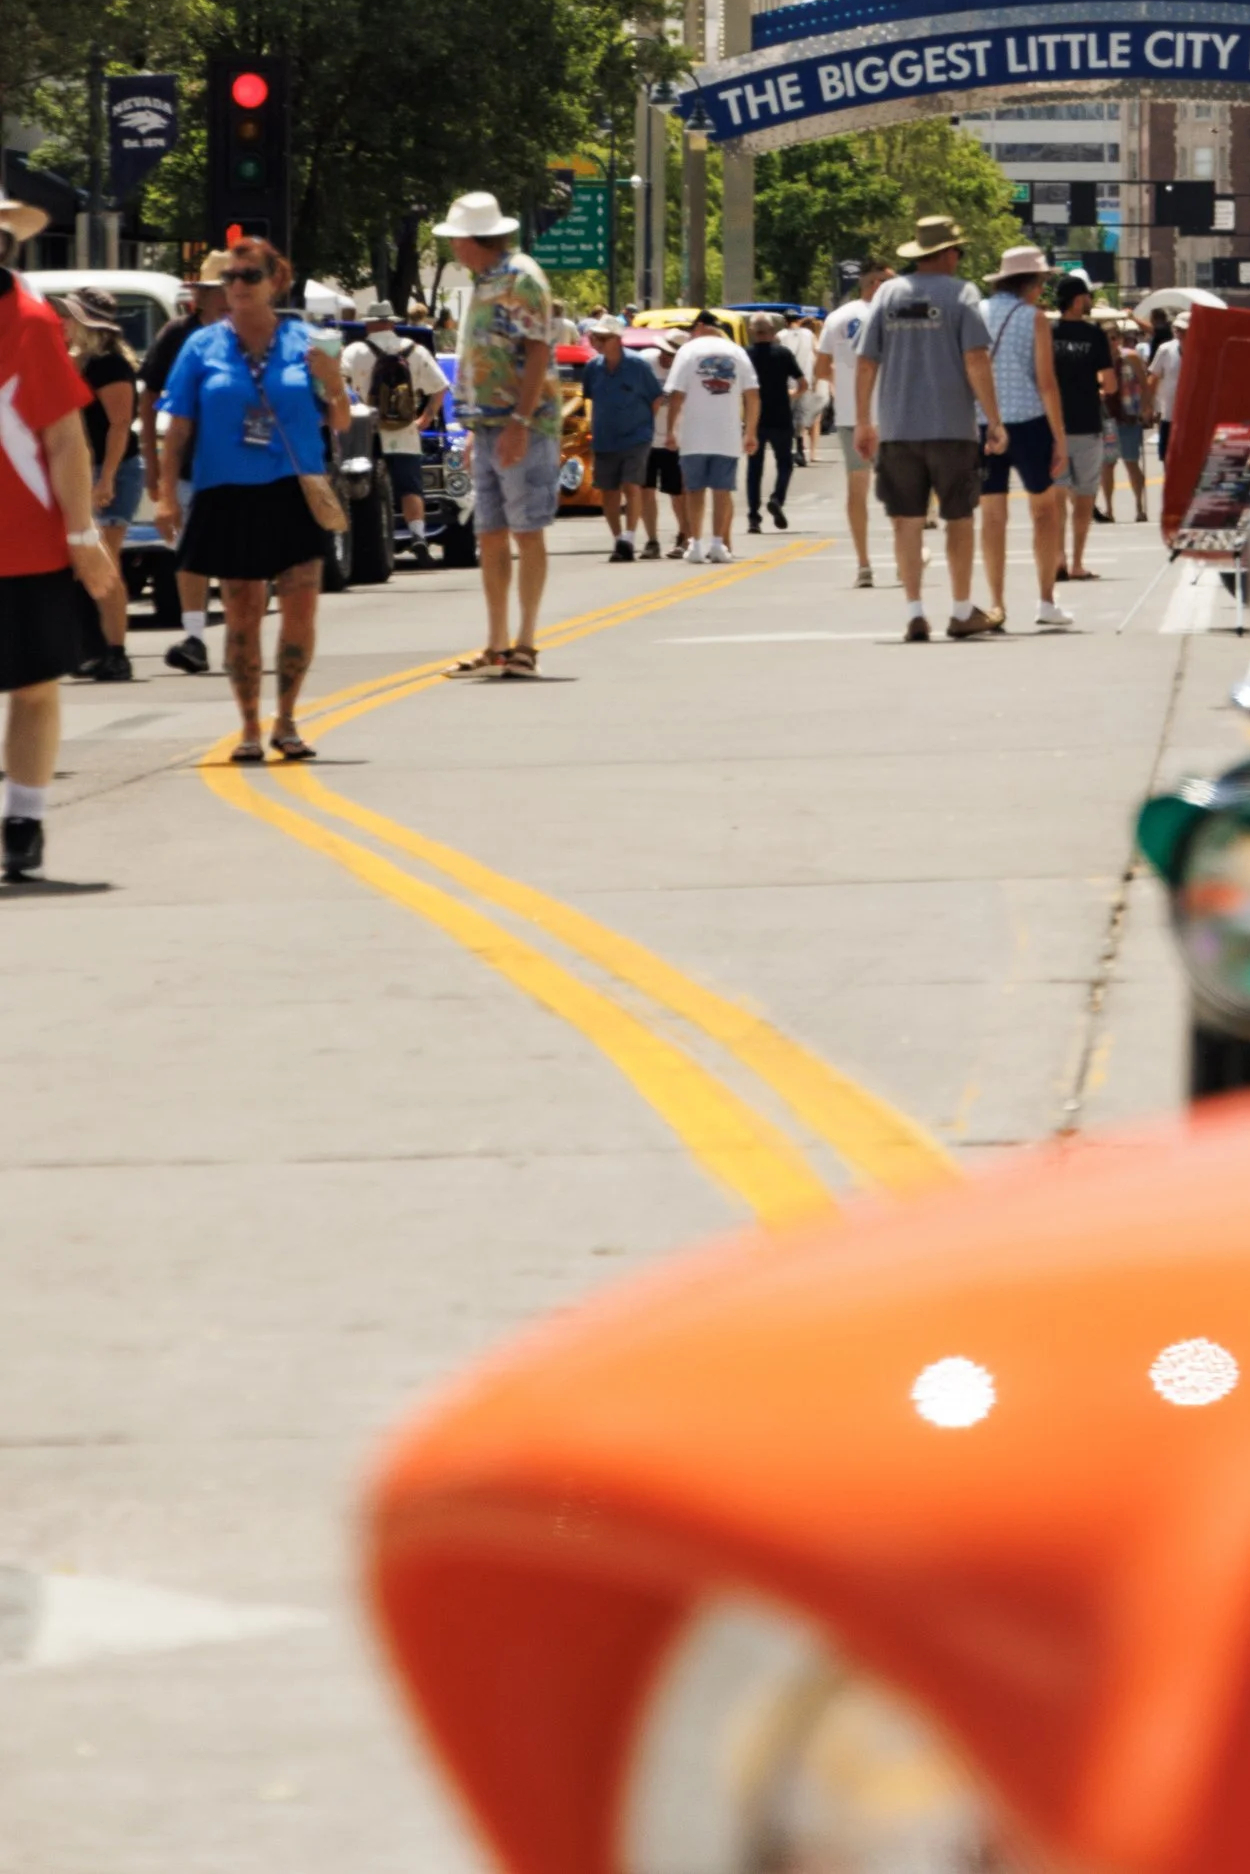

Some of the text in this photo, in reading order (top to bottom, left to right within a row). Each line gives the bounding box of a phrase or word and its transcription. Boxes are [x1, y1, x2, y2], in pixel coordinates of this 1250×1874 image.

[112, 96, 173, 117] NEVADA
[718, 72, 804, 125] THE
[817, 40, 992, 103] BIGGEST
[1006, 32, 1131, 73] LITTLE
[1144, 31, 1240, 70] CITY
